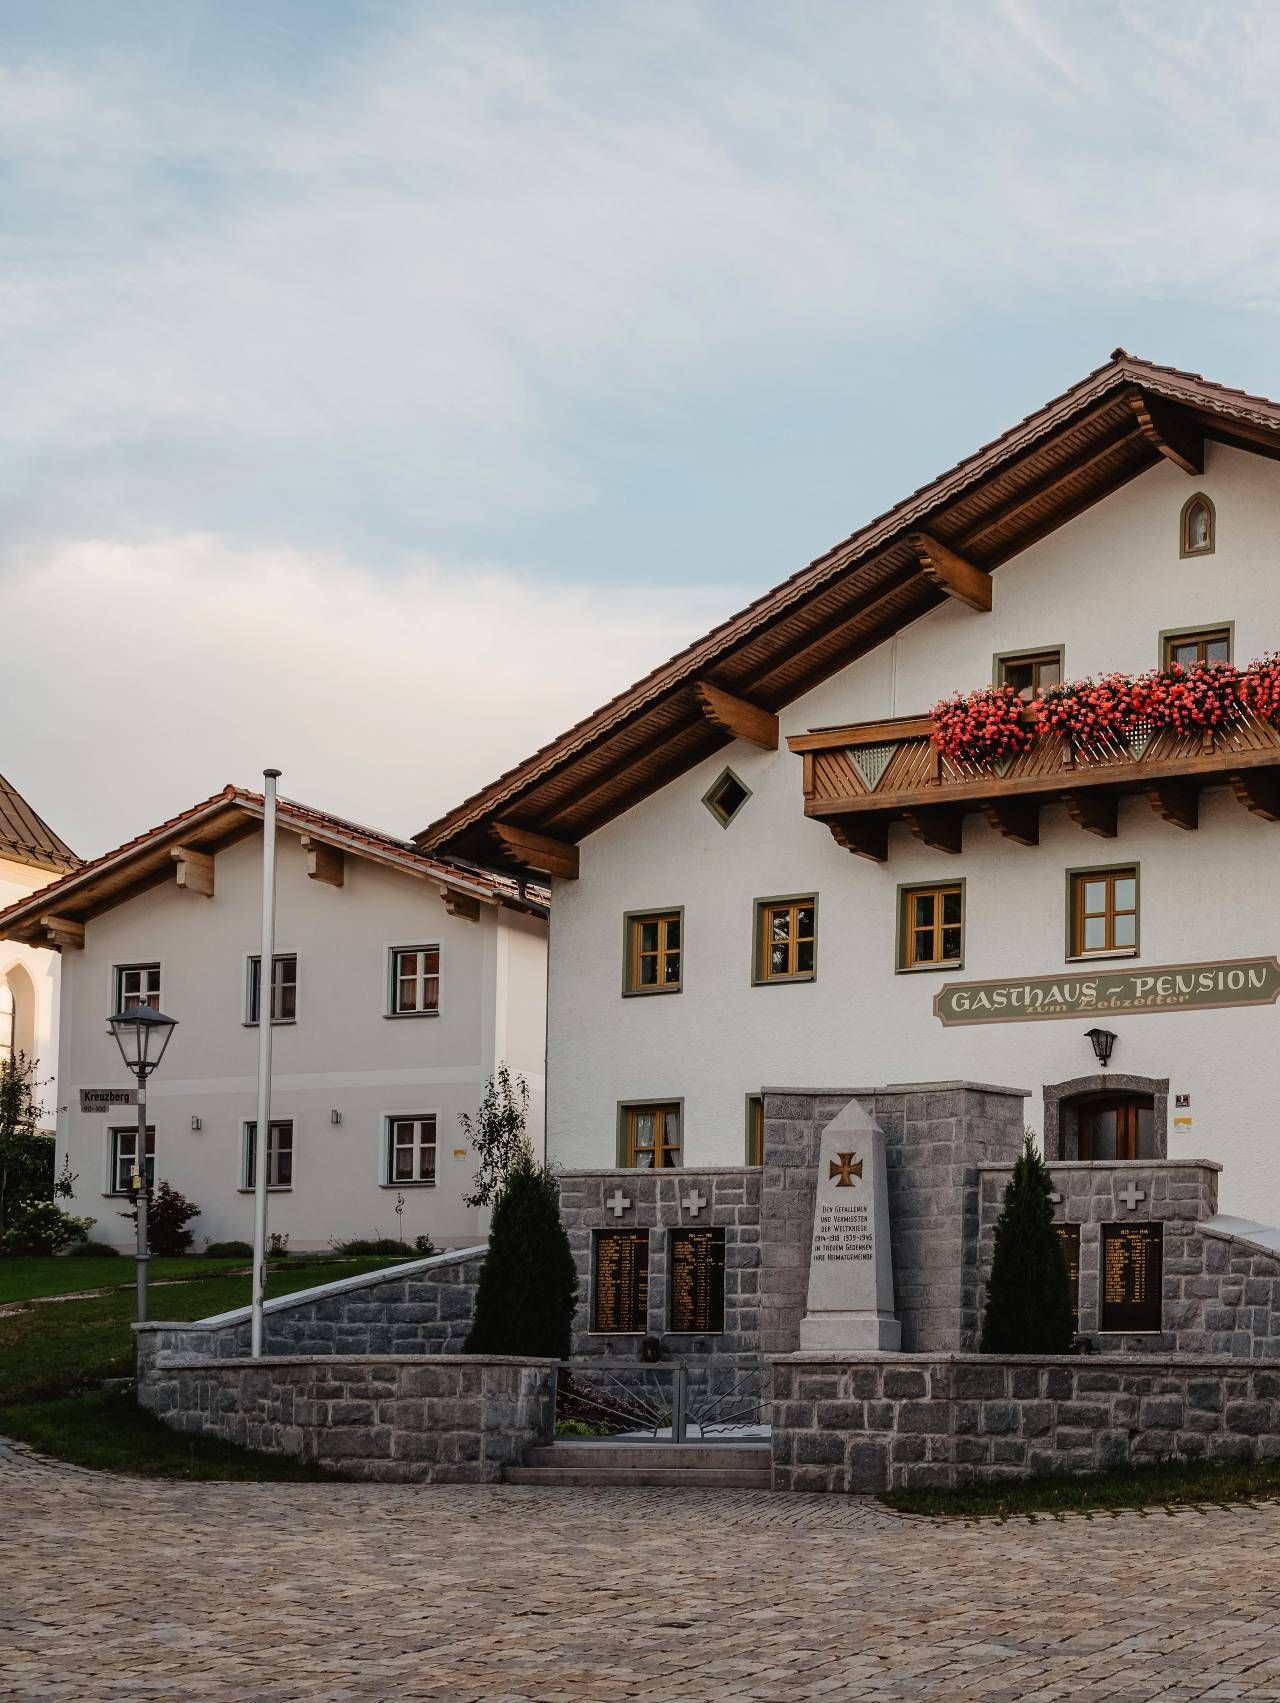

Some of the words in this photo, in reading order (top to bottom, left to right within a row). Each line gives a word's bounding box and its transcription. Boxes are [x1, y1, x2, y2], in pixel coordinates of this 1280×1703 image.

[951, 979, 1099, 1012] GASTHAUS
[1130, 968, 1266, 998] PENSION
[1025, 1004, 1067, 1013] zum
[84, 1091, 130, 1104] Kreuzberg
